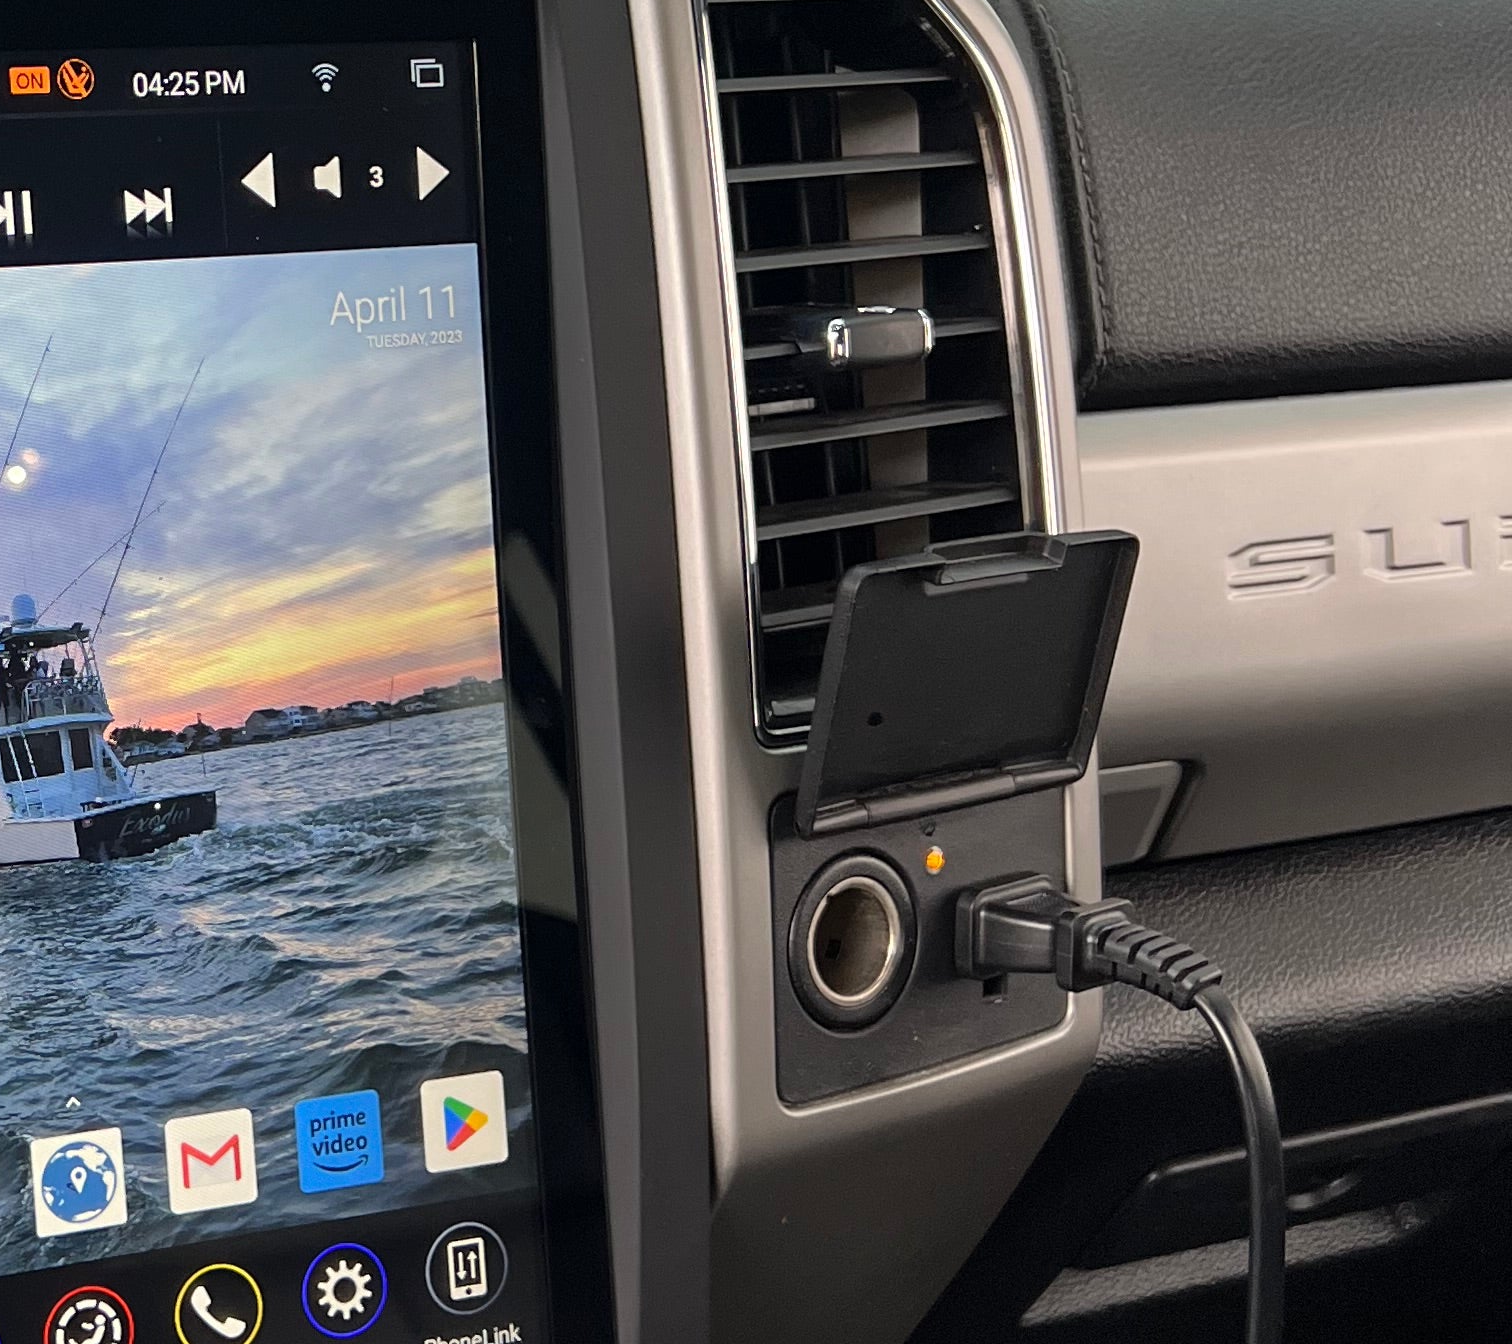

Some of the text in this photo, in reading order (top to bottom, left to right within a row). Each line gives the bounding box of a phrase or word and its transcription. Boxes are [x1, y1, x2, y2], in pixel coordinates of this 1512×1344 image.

[15, 71, 44, 90] ON
[132, 68, 246, 99] 04:25 PM
[368, 167, 384, 188] 3
[330, 284, 455, 334] April 11
[431, 329, 464, 345] 2023
[1227, 514, 1512, 601] SU
[309, 1108, 367, 1138] prime
[311, 1131, 368, 1157] video
